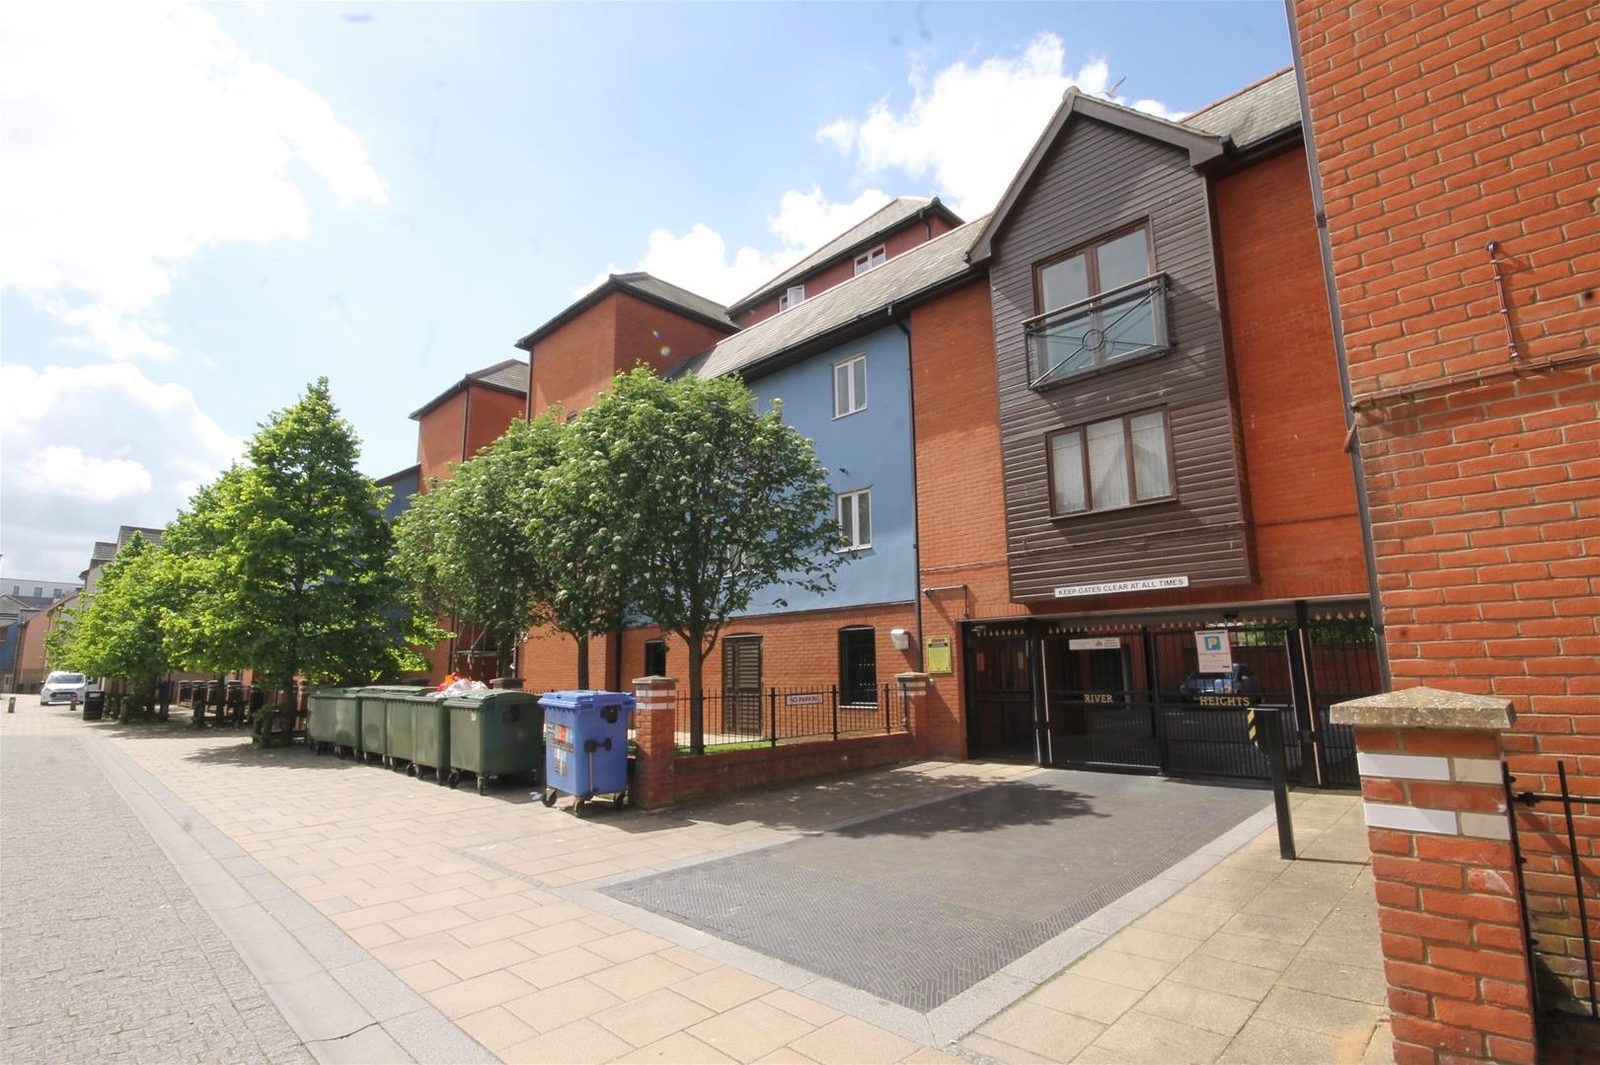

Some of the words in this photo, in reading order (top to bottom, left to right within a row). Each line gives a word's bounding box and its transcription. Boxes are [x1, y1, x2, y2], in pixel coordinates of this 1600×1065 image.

[1058, 588, 1076, 596] KEEP
[1078, 585, 1101, 594] GATES
[1103, 583, 1128, 592] CLEAR
[1159, 579, 1184, 587] TIMES
[1207, 637, 1218, 649] P
[1083, 694, 1113, 703] RIVER
[1200, 696, 1250, 706] HEIGHTS
